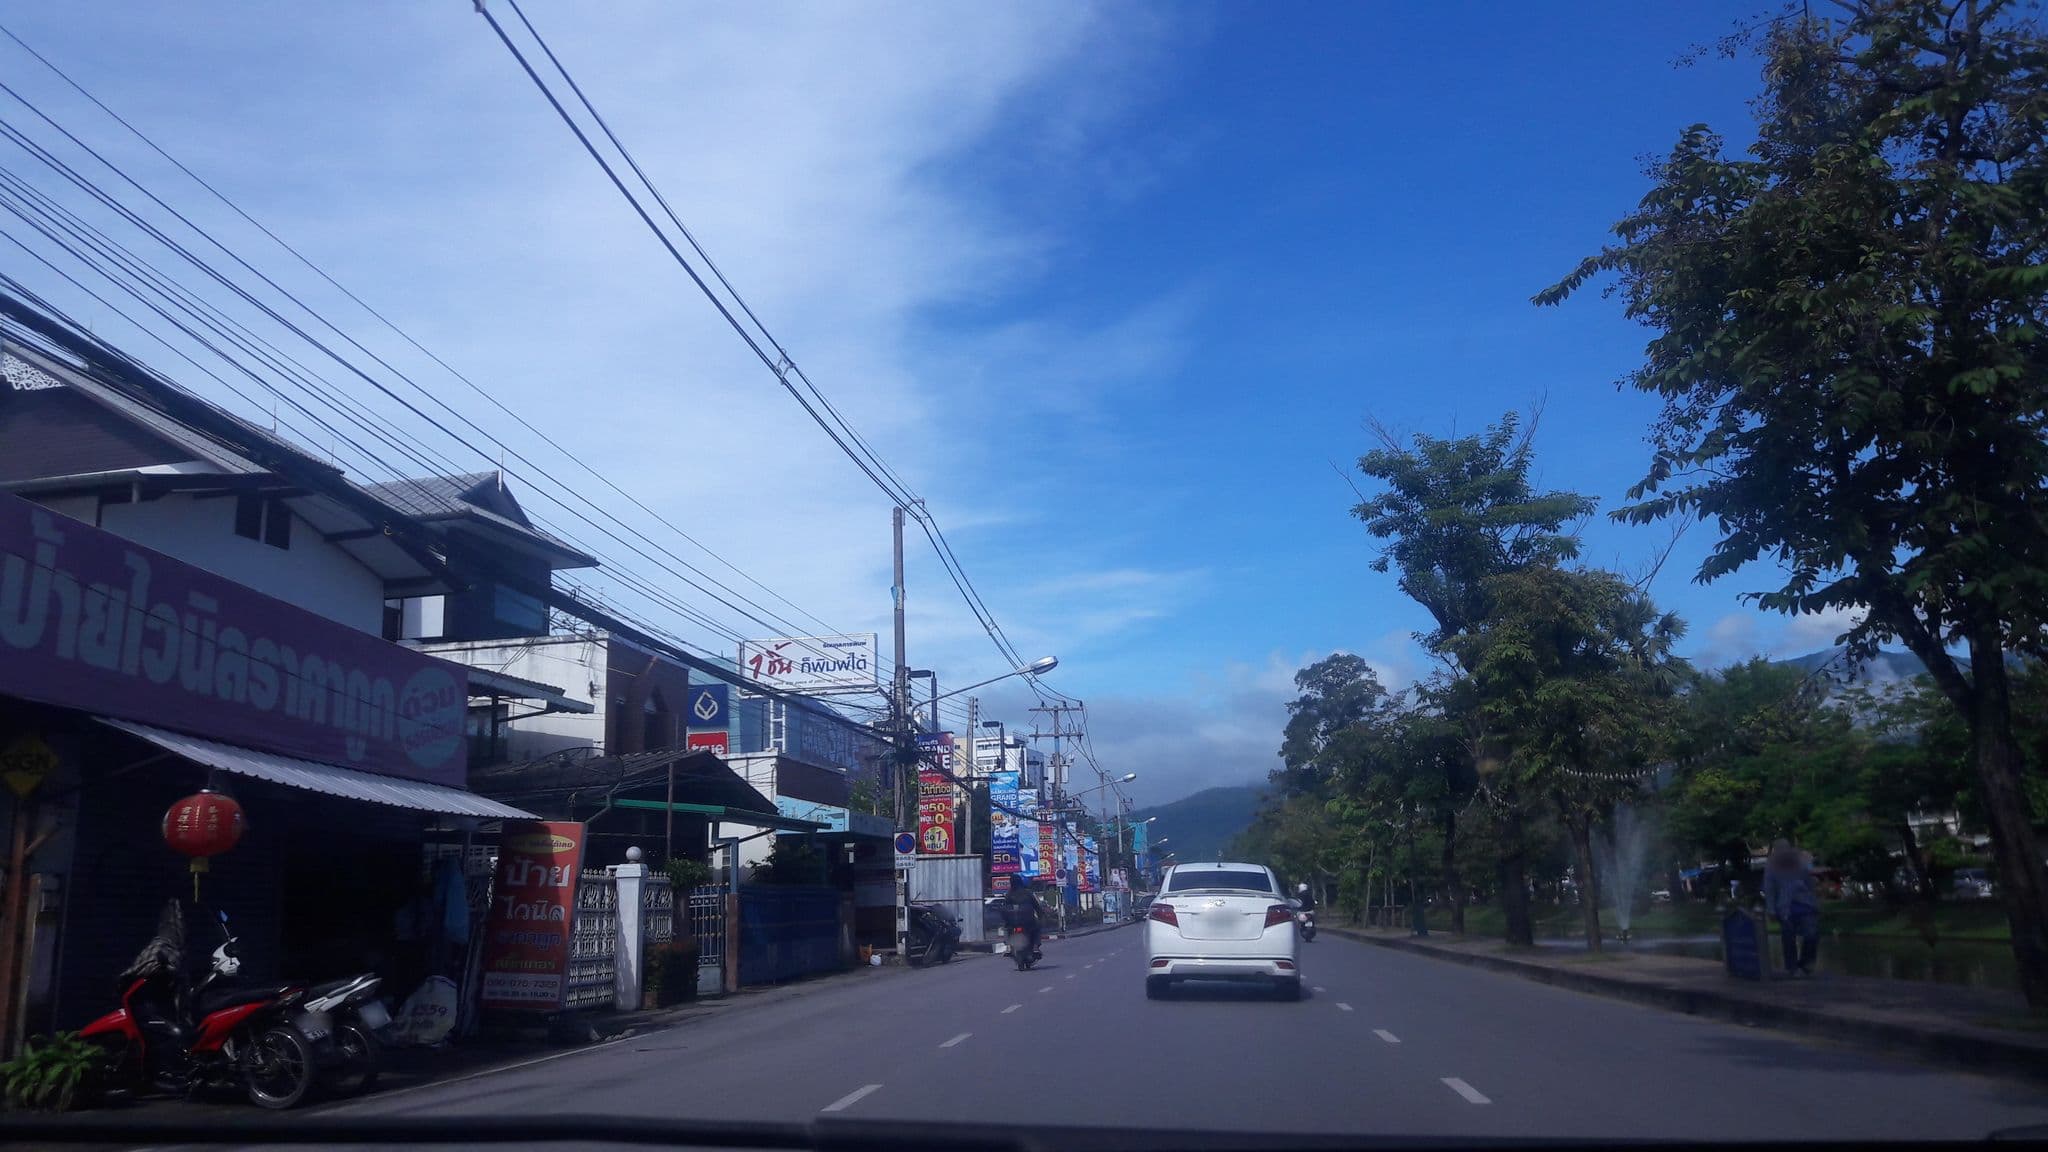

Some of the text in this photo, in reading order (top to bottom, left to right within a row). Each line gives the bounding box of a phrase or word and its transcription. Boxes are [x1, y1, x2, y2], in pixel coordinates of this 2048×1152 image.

[0, 509, 394, 761] ป้ายไวนิลราคาถูก
[749, 641, 867, 680] 1 ชิ้น ก็พิมพ์ได้
[503, 855, 572, 888] ป้าย
[497, 895, 566, 921] ไวนิล
